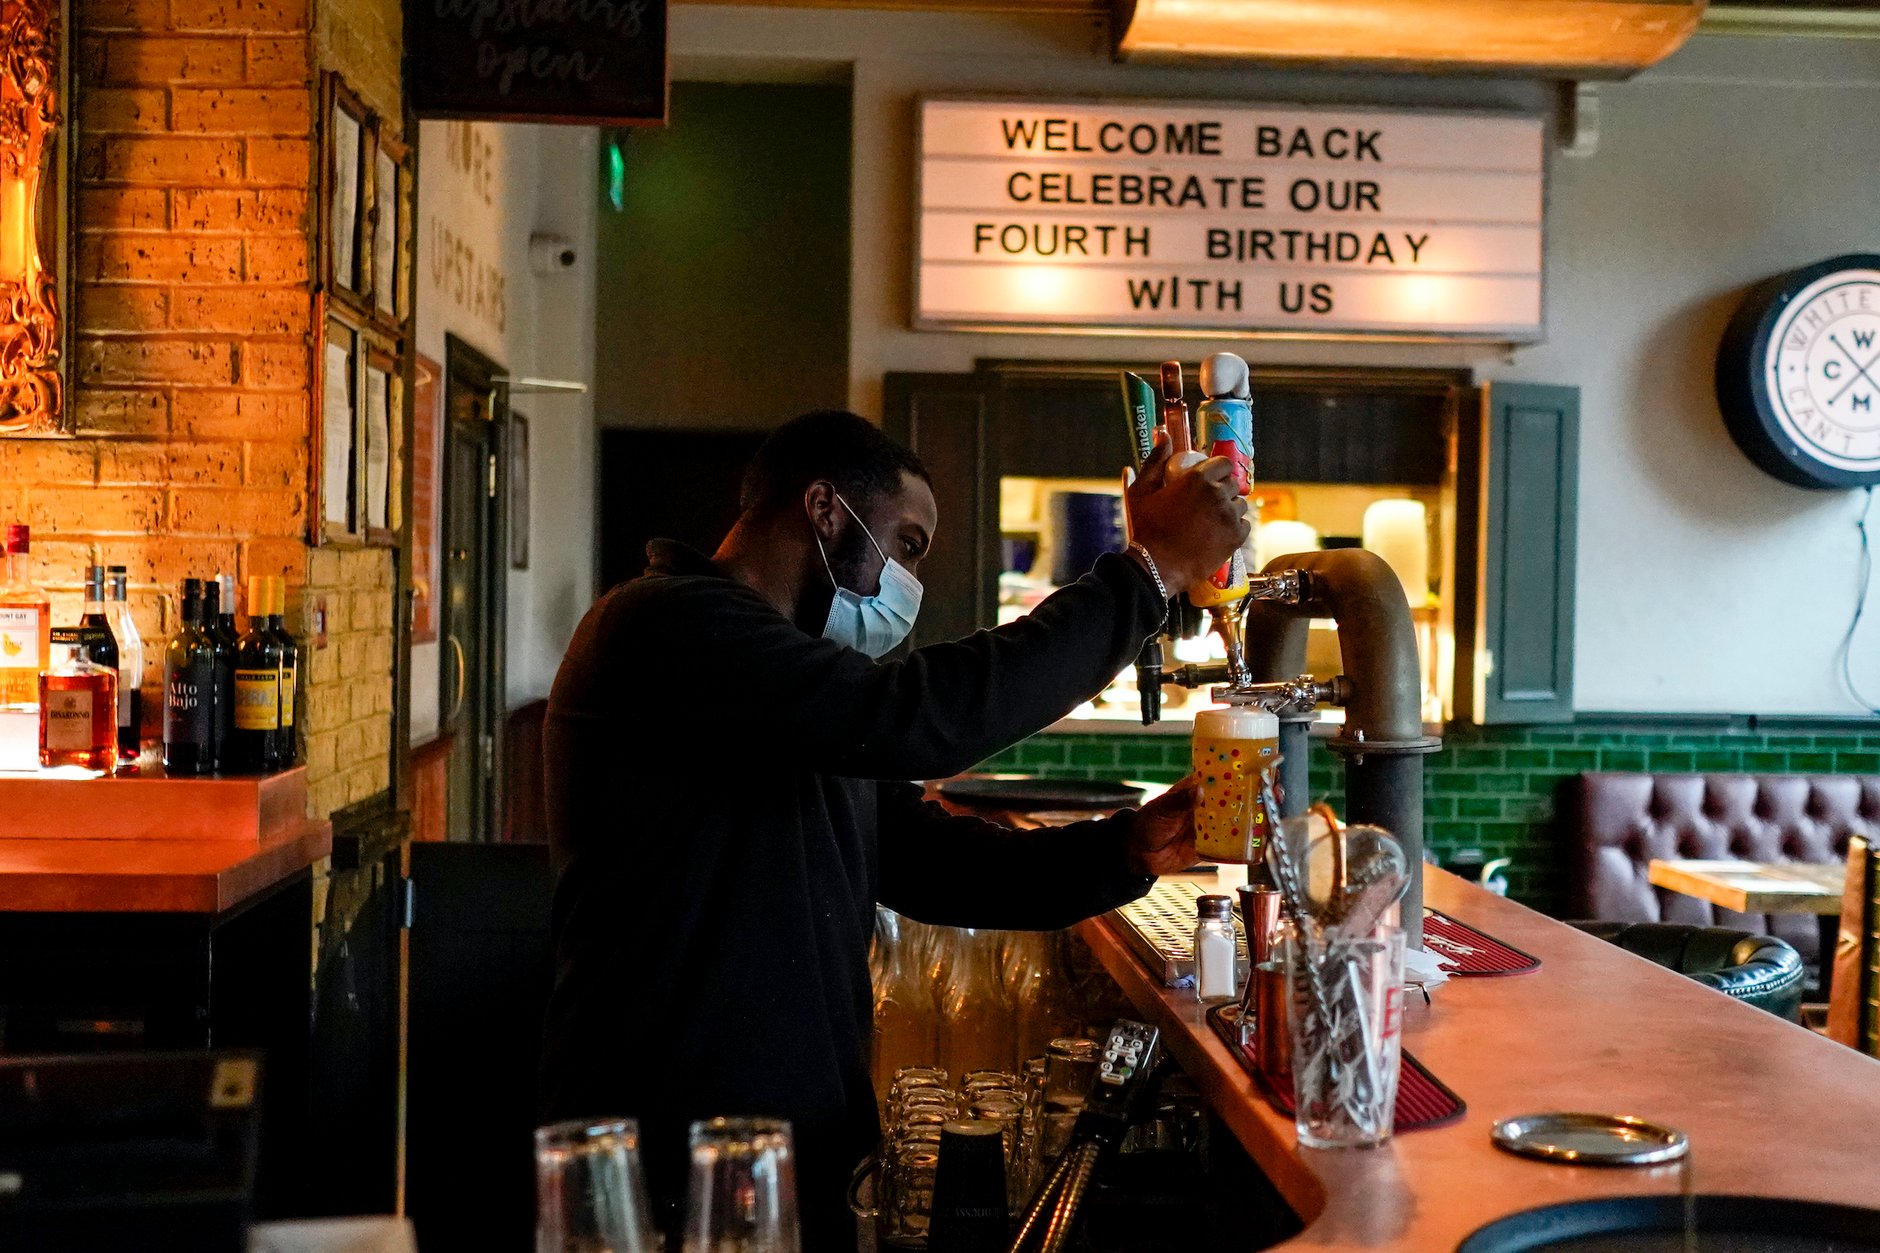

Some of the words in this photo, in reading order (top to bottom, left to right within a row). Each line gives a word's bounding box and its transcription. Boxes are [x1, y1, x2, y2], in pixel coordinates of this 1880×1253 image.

[1002, 118, 1222, 155] WELCOME
[1256, 126, 1383, 162] BACK
[1008, 171, 1265, 208] CELEBRATE
[1289, 178, 1381, 211] OUR
[975, 224, 1150, 256] FOURTH
[1206, 228, 1429, 264] BIRTHDAY
[1127, 274, 1242, 310] WITH
[1279, 282, 1333, 313] US
[1786, 288, 1872, 351] WHITE
[1135, 404, 1151, 467] eineken
